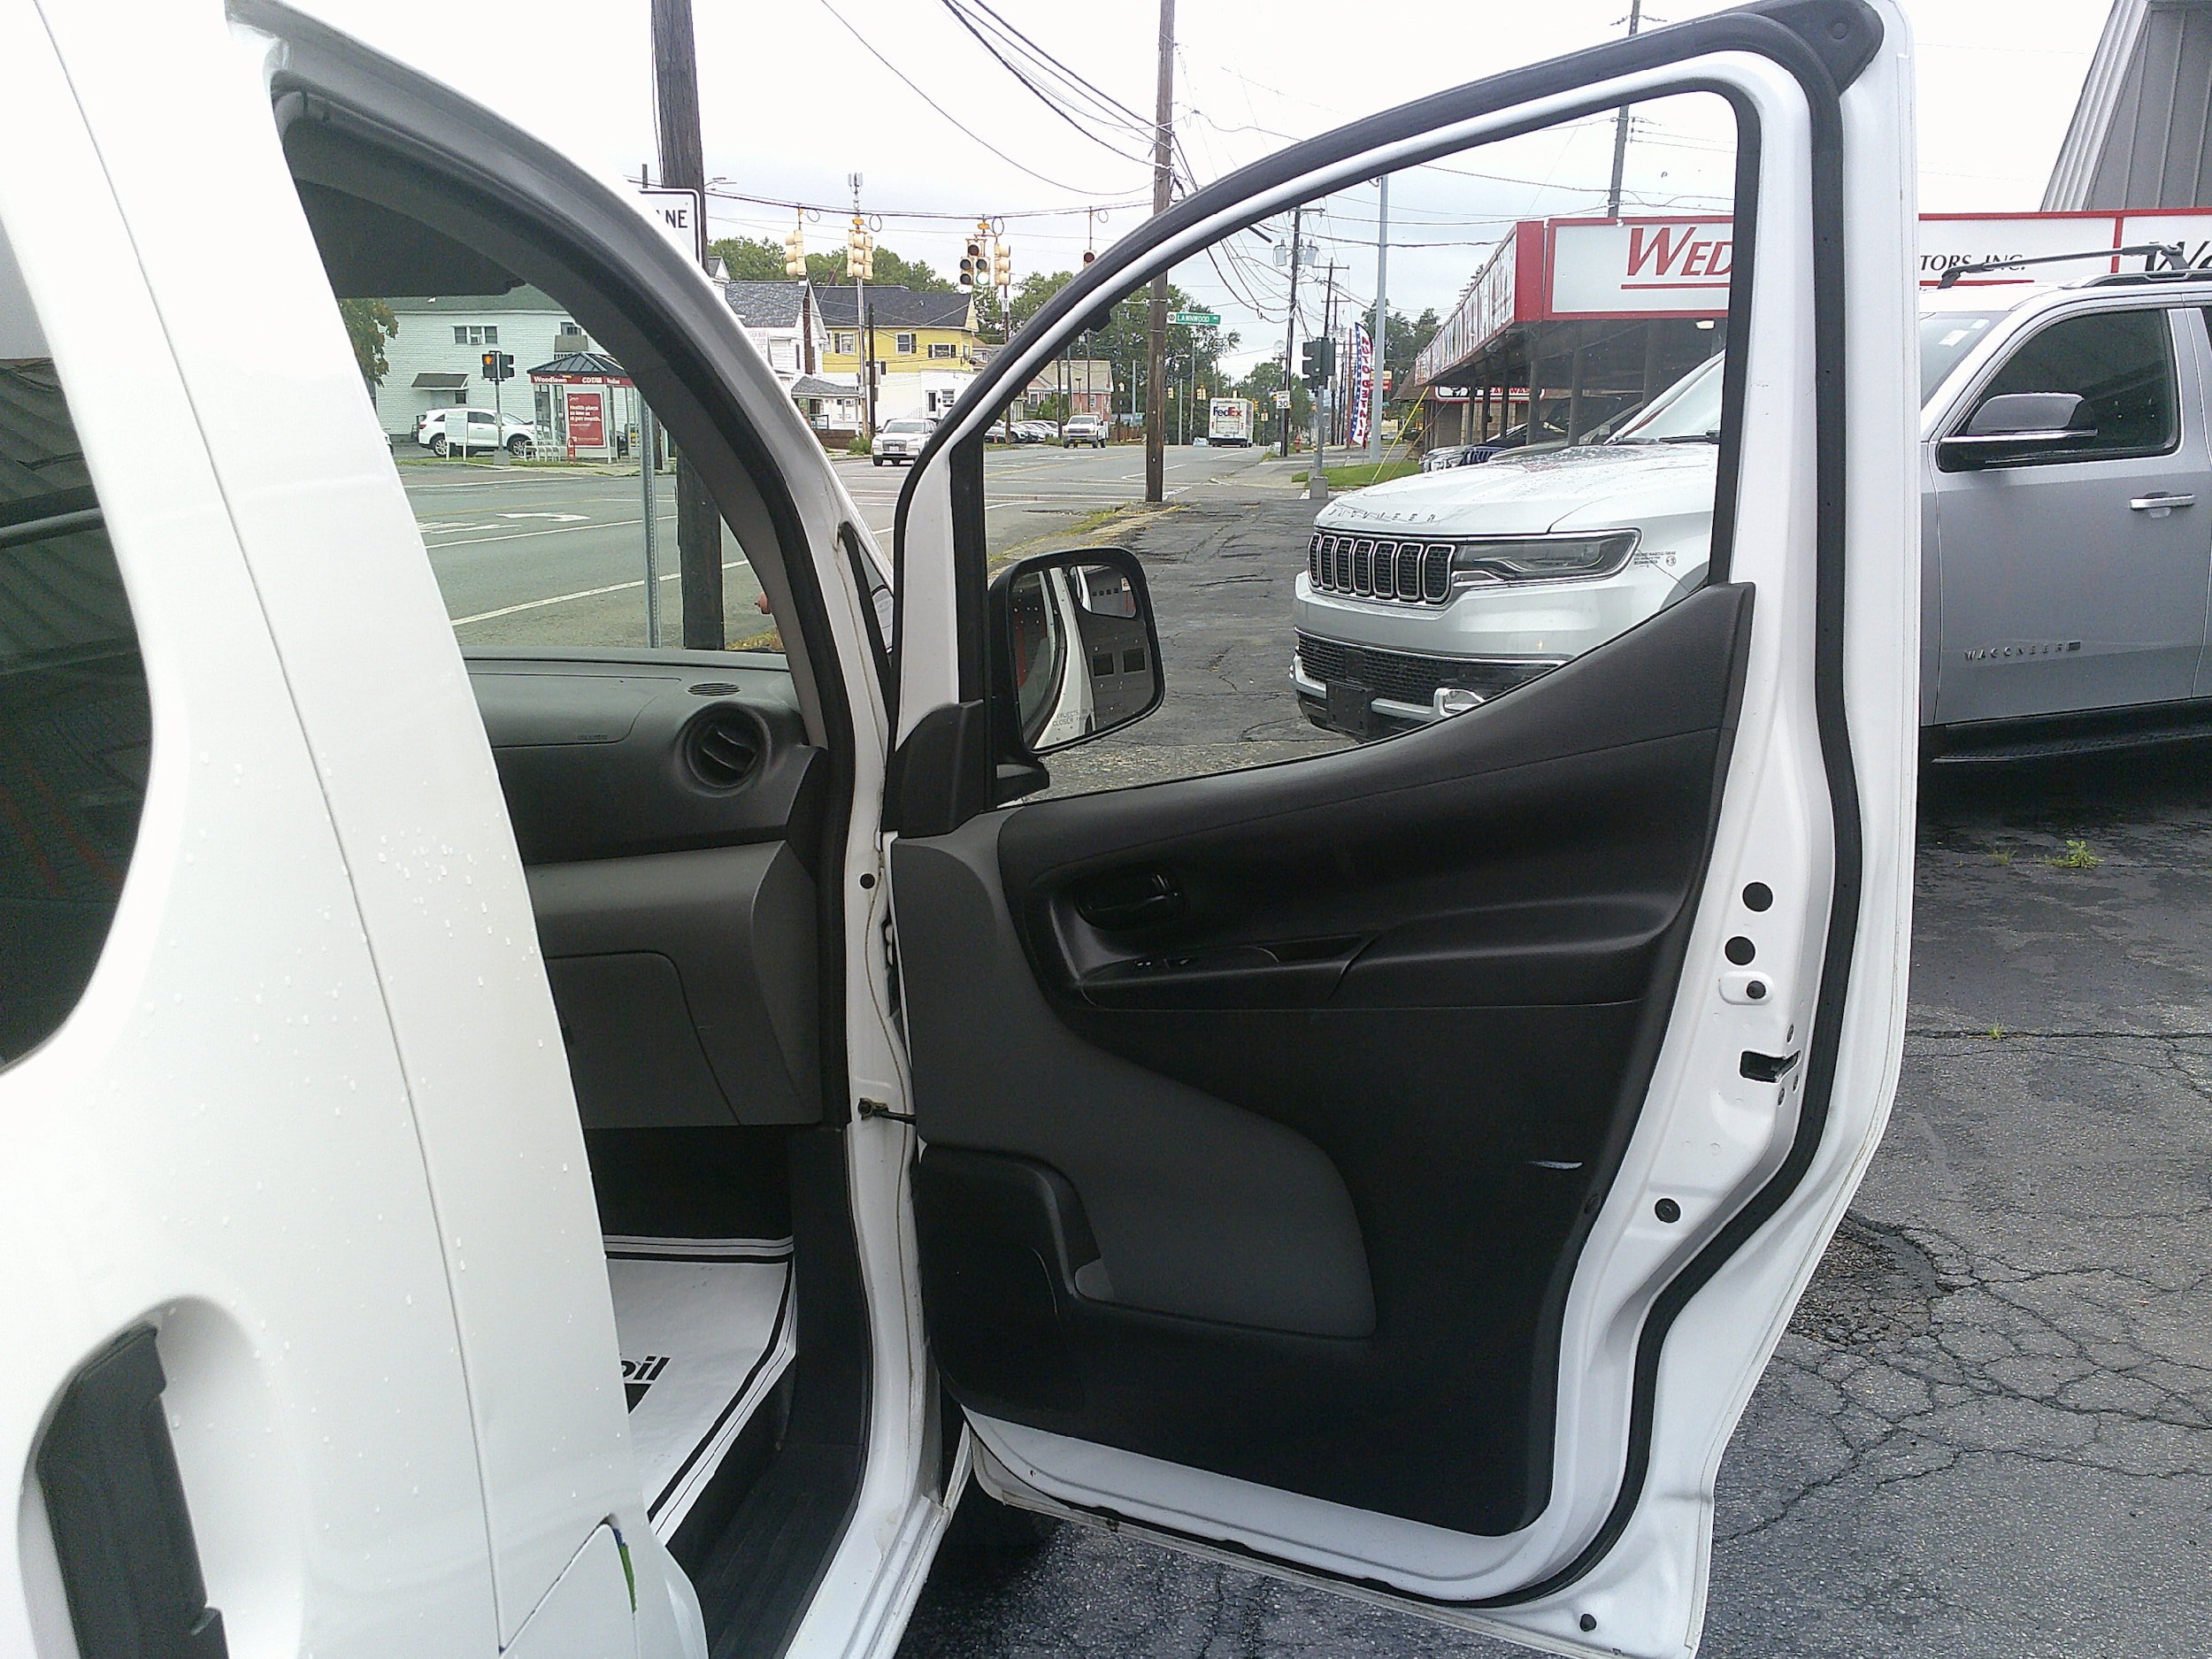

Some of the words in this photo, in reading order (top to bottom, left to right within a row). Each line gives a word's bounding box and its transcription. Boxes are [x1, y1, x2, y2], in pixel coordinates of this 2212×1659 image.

[657, 210, 687, 228] NE
[1627, 227, 1732, 276] WED
[1213, 406, 1243, 417] FedEx
[1964, 642, 2063, 661] WAGONEER
